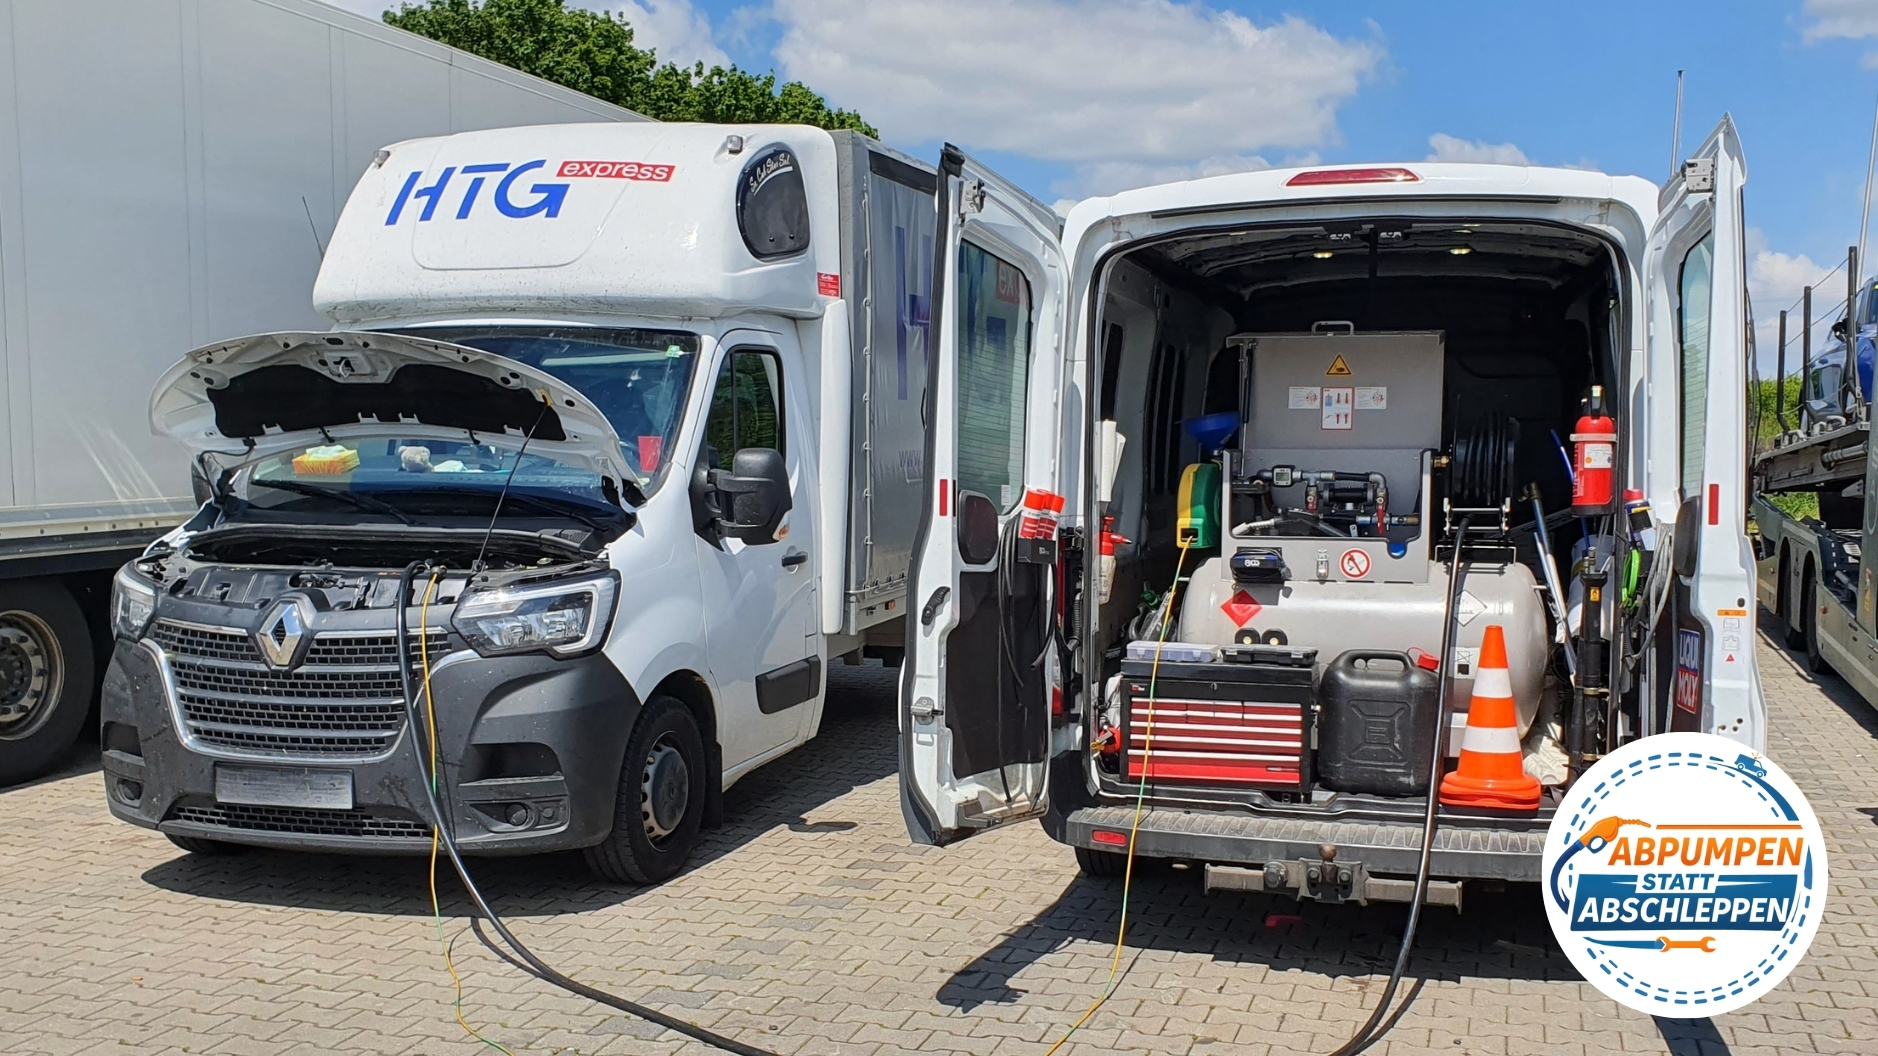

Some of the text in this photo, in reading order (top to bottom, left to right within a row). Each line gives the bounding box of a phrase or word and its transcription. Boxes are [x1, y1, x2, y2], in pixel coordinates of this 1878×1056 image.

[563, 162, 669, 181] express
[384, 159, 571, 226] HTG
[1680, 632, 1700, 670] LIQUI
[1677, 671, 1698, 708] MOLY
